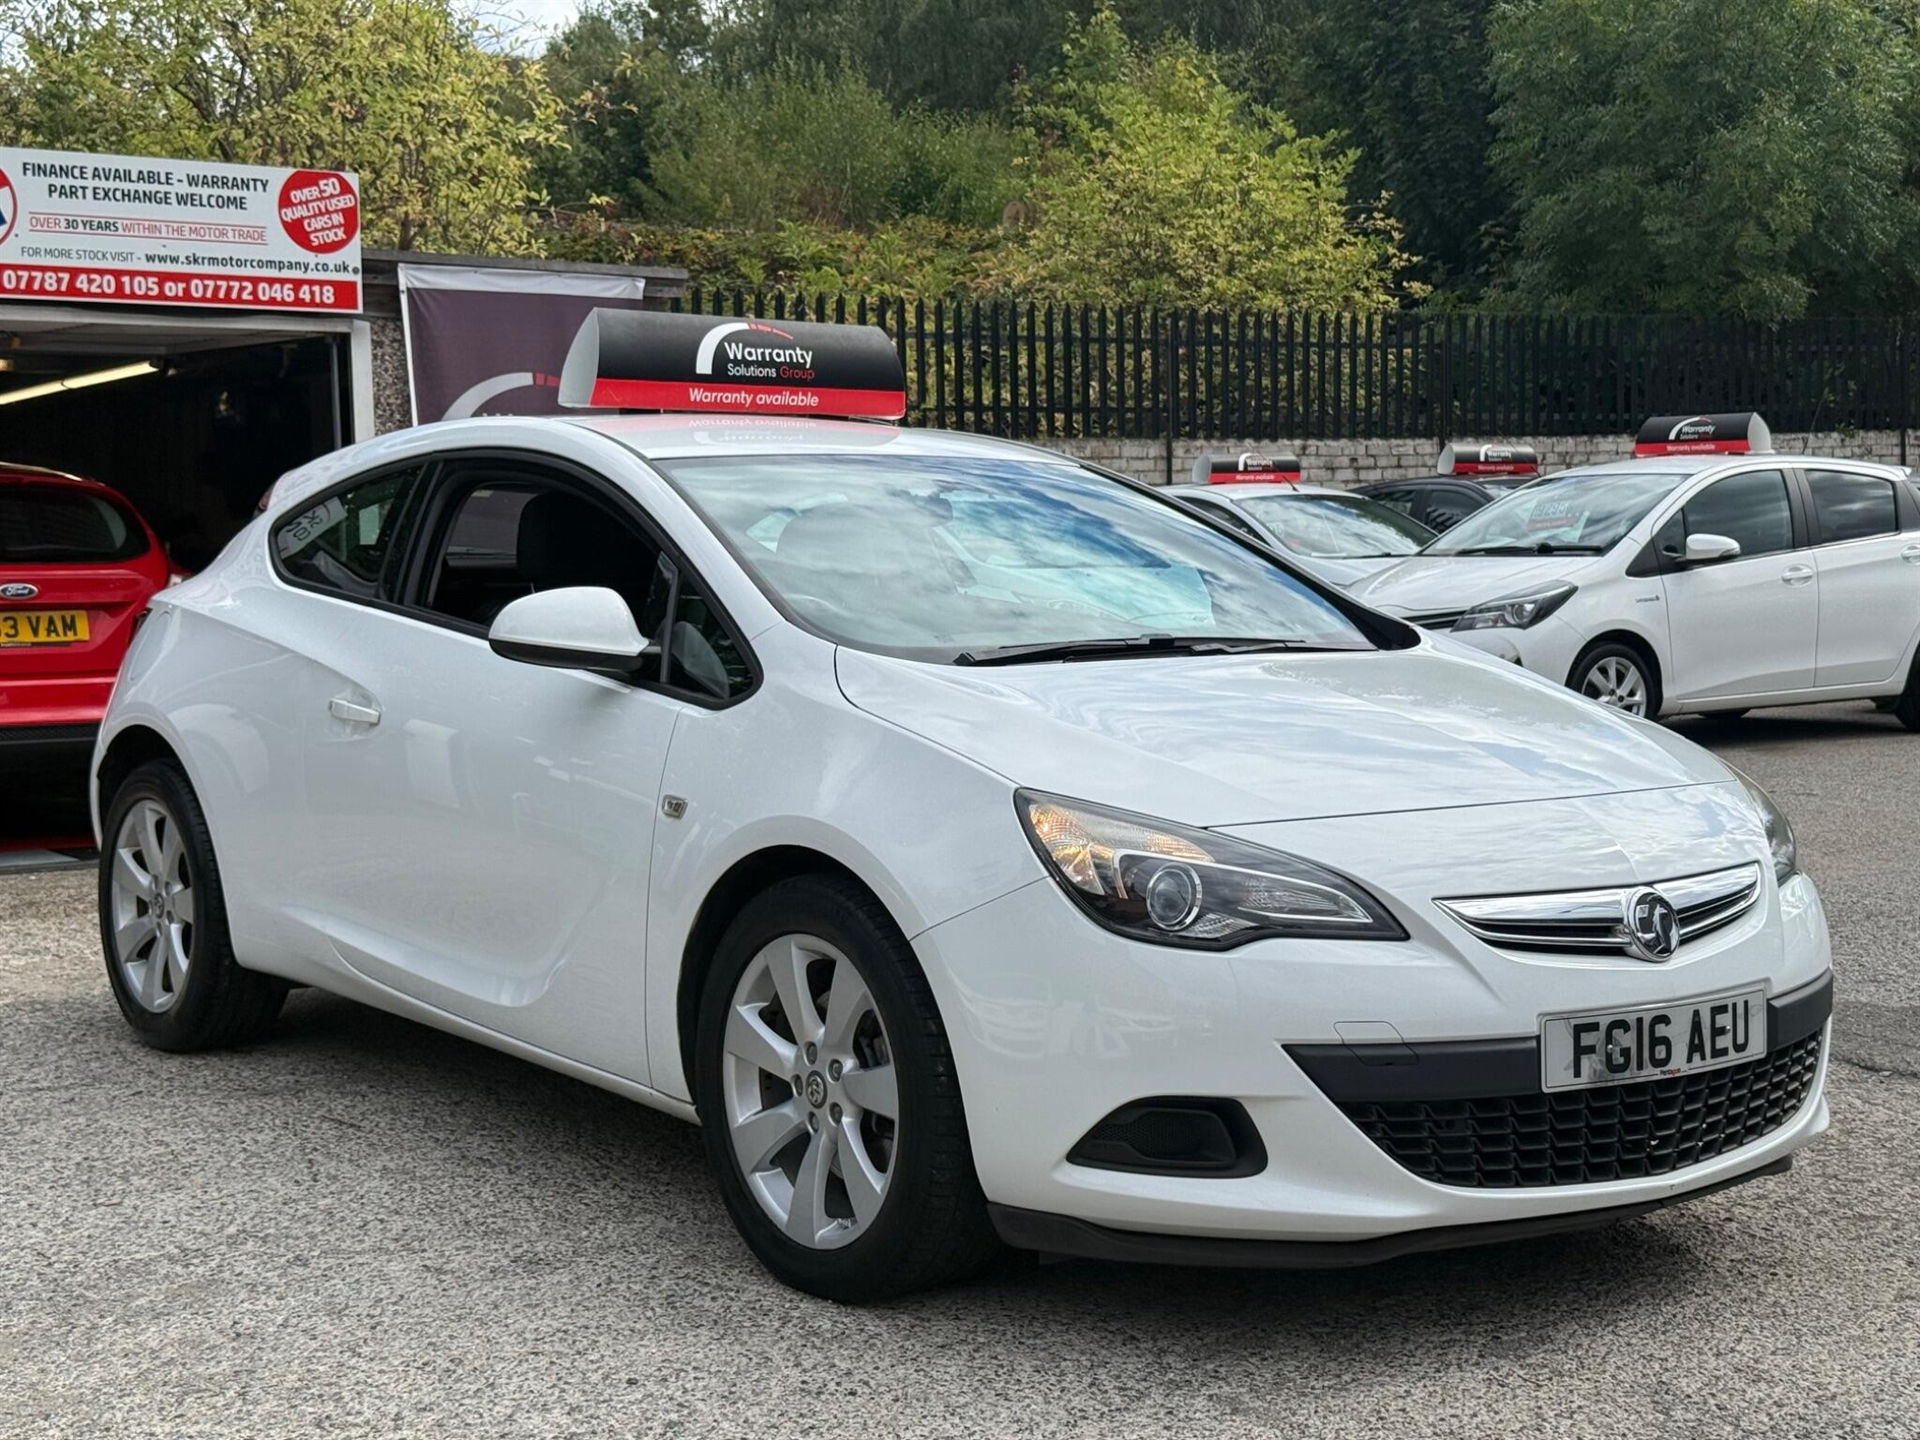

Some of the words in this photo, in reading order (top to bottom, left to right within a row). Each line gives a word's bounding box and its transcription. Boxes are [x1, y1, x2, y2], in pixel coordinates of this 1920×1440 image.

[22, 162, 89, 180] FINANCE
[92, 167, 174, 186] AVAILABLE
[186, 173, 269, 193] WARRANTY
[48, 184, 88, 200] PART
[93, 187, 173, 205] EXCHANGE
[176, 192, 248, 211] WELCOME
[290, 186, 321, 204] OVER
[318, 178, 341, 197] 50
[281, 200, 327, 223] QUALITY
[326, 194, 356, 212] USED
[30, 216, 62, 229] OVER
[64, 218, 79, 230] 30
[81, 219, 119, 232] YEARS
[121, 222, 162, 235] WITHIN
[165, 225, 187, 237] THE
[189, 225, 229, 238] MOTOR
[231, 227, 267, 241] TRADE
[303, 214, 332, 232] CARS
[330, 211, 345, 226] IN
[310, 227, 347, 246] STOCK
[21, 246, 42, 258] FOR
[44, 248, 74, 259] MORE
[76, 249, 108, 261] STOCK
[108, 252, 135, 263] VISIT
[145, 252, 350, 274] www.skrmotorcompany.co.uk
[2, 269, 71, 292] 07787
[75, 272, 116, 294] 420
[121, 275, 160, 297] 105
[164, 281, 187, 297] or
[190, 279, 253, 301] 07772
[257, 282, 295, 302] 046
[298, 284, 335, 304] 418
[724, 341, 813, 369] Warranty
[727, 363, 777, 378] Solutions
[780, 366, 815, 381] Group
[689, 387, 753, 408] Warranty
[756, 391, 819, 407] available
[1681, 424, 1716, 434] Warranty
[6, 586, 30, 596] Ford
[0, 616, 19, 639] 3
[26, 614, 78, 638] VAM
[1572, 1013, 1673, 1079] FG16
[1686, 999, 1749, 1064] AEU
